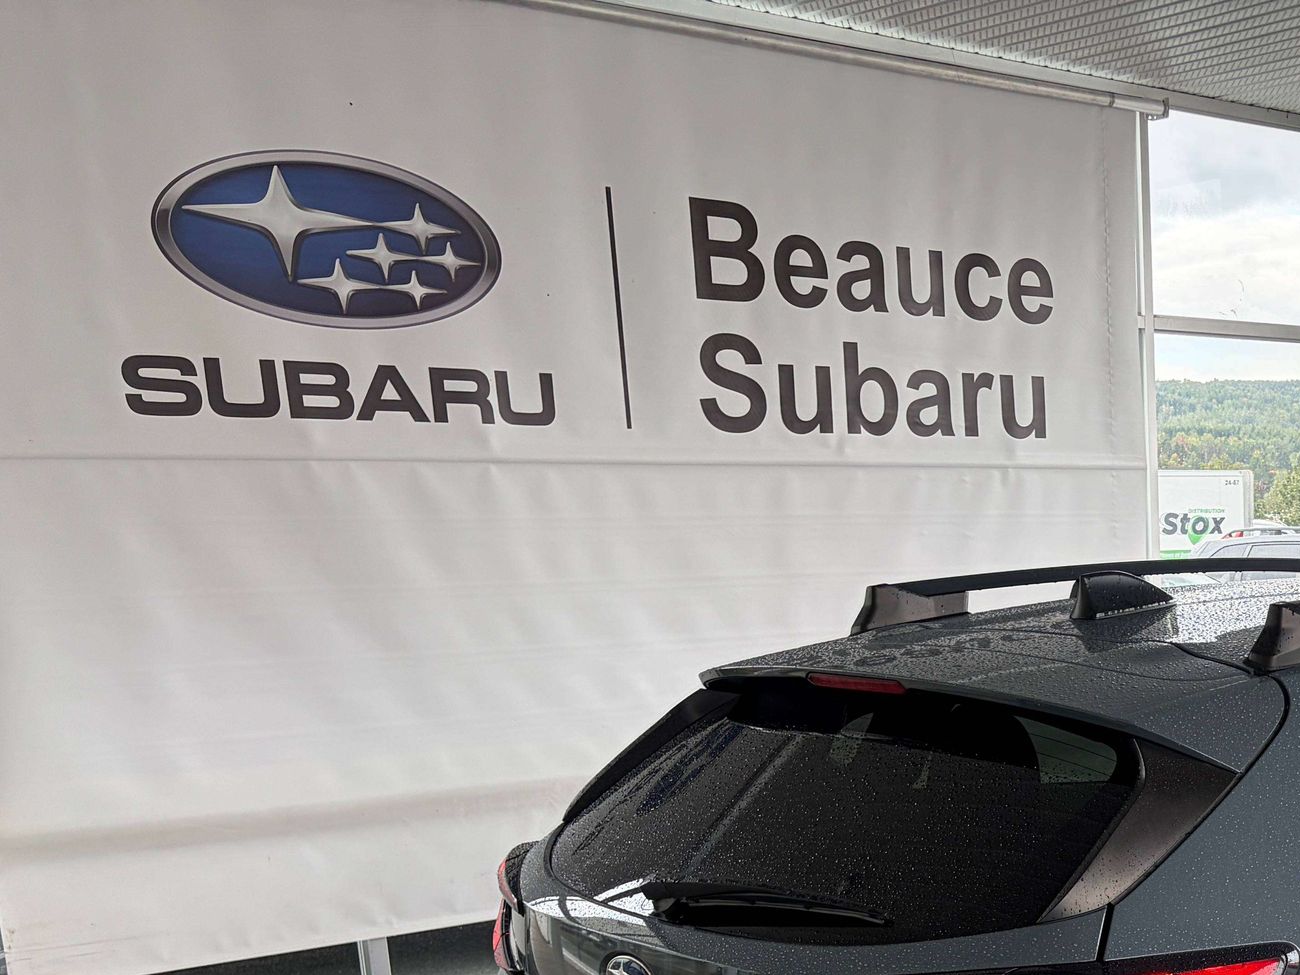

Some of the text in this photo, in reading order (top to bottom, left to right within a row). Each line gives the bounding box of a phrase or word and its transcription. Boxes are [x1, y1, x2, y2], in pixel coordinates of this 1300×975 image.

[688, 196, 1055, 325] Beauce
[120, 354, 556, 426] SUBARU
[699, 332, 1047, 440] Subaru
[1162, 512, 1225, 535] Stox
